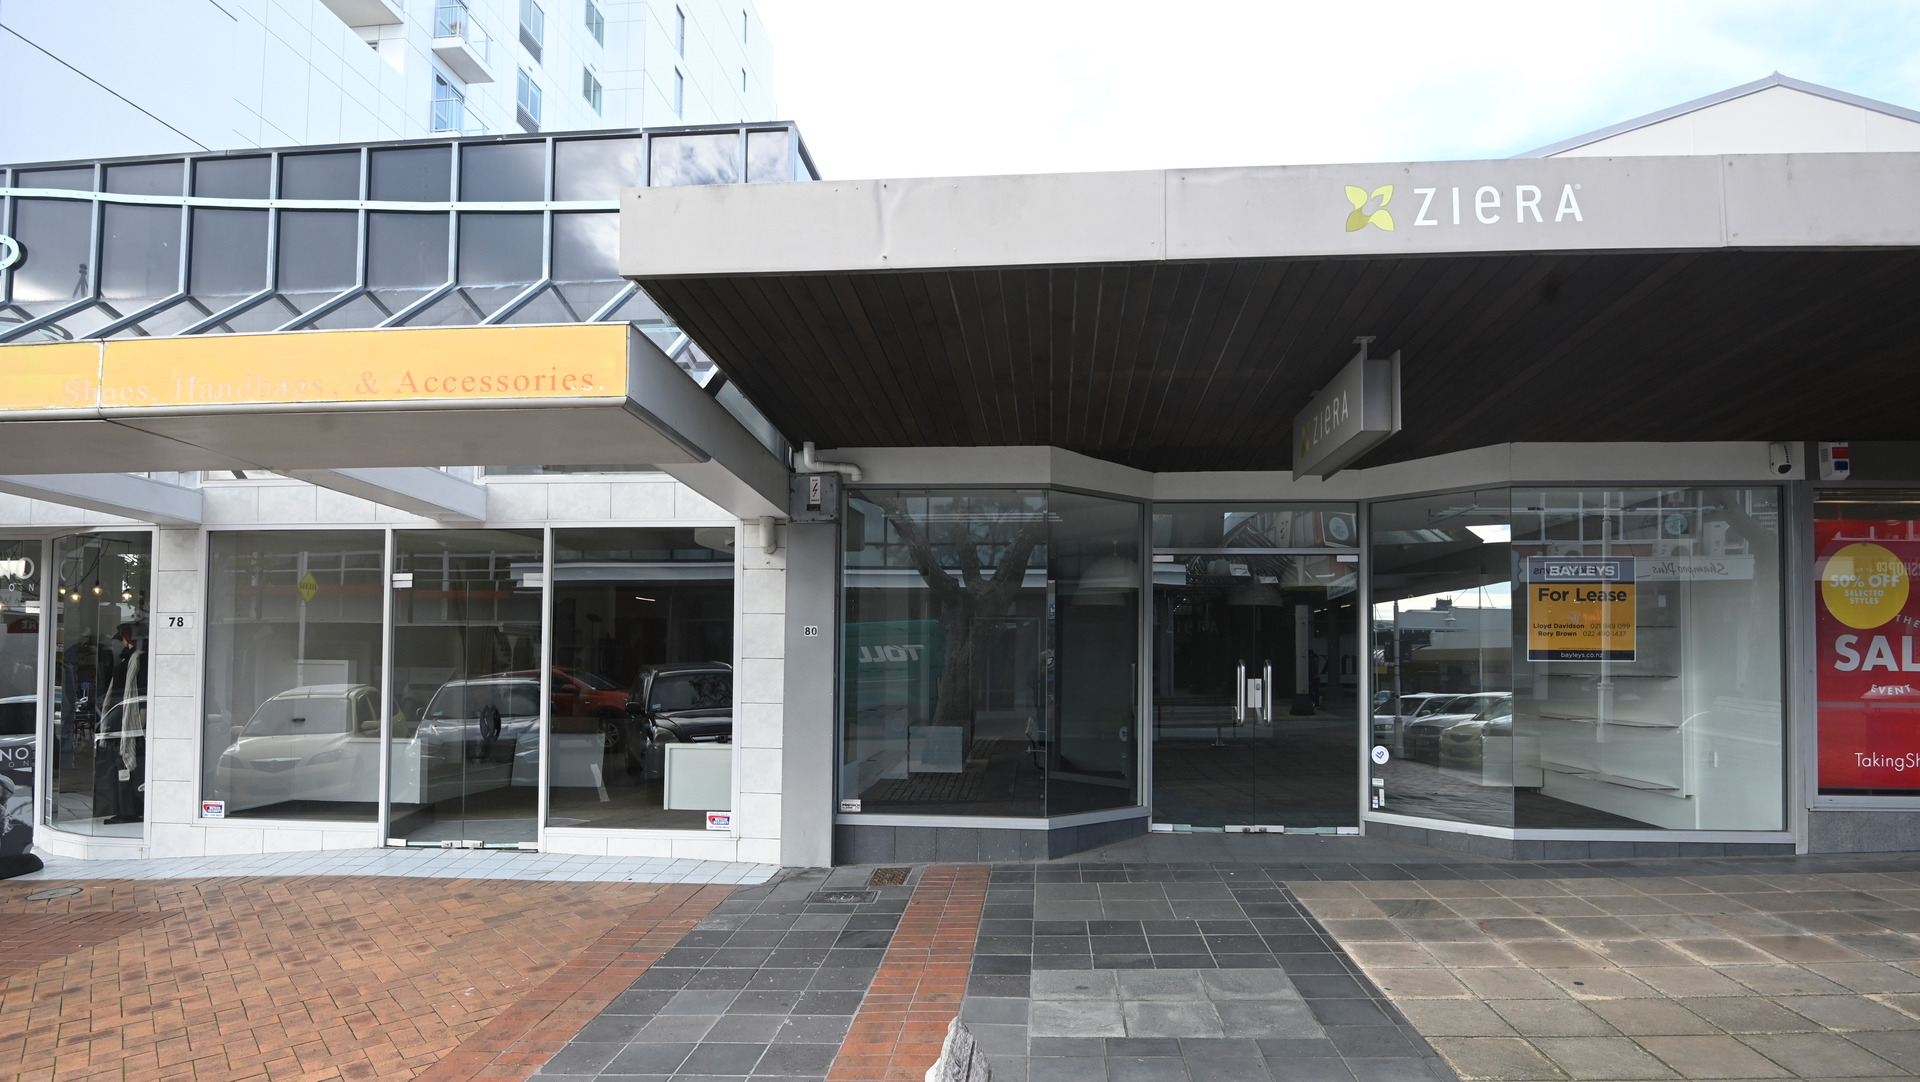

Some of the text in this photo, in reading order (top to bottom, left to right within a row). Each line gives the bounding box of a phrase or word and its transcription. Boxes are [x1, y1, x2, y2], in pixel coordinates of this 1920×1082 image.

[354, 370, 380, 395] &
[1549, 565, 1615, 576] BAYLEYS
[1830, 574, 1900, 588] 50% OFF
[1538, 587, 1627, 602] For Lease
[1844, 589, 1884, 597] SELECTED
[168, 616, 184, 628] 78
[1896, 614, 1920, 628] THE
[804, 626, 818, 636] 80
[1561, 651, 1604, 660] bayleys.co.nz
[1833, 633, 1920, 672] SAL
[1870, 683, 1911, 696] EVENT
